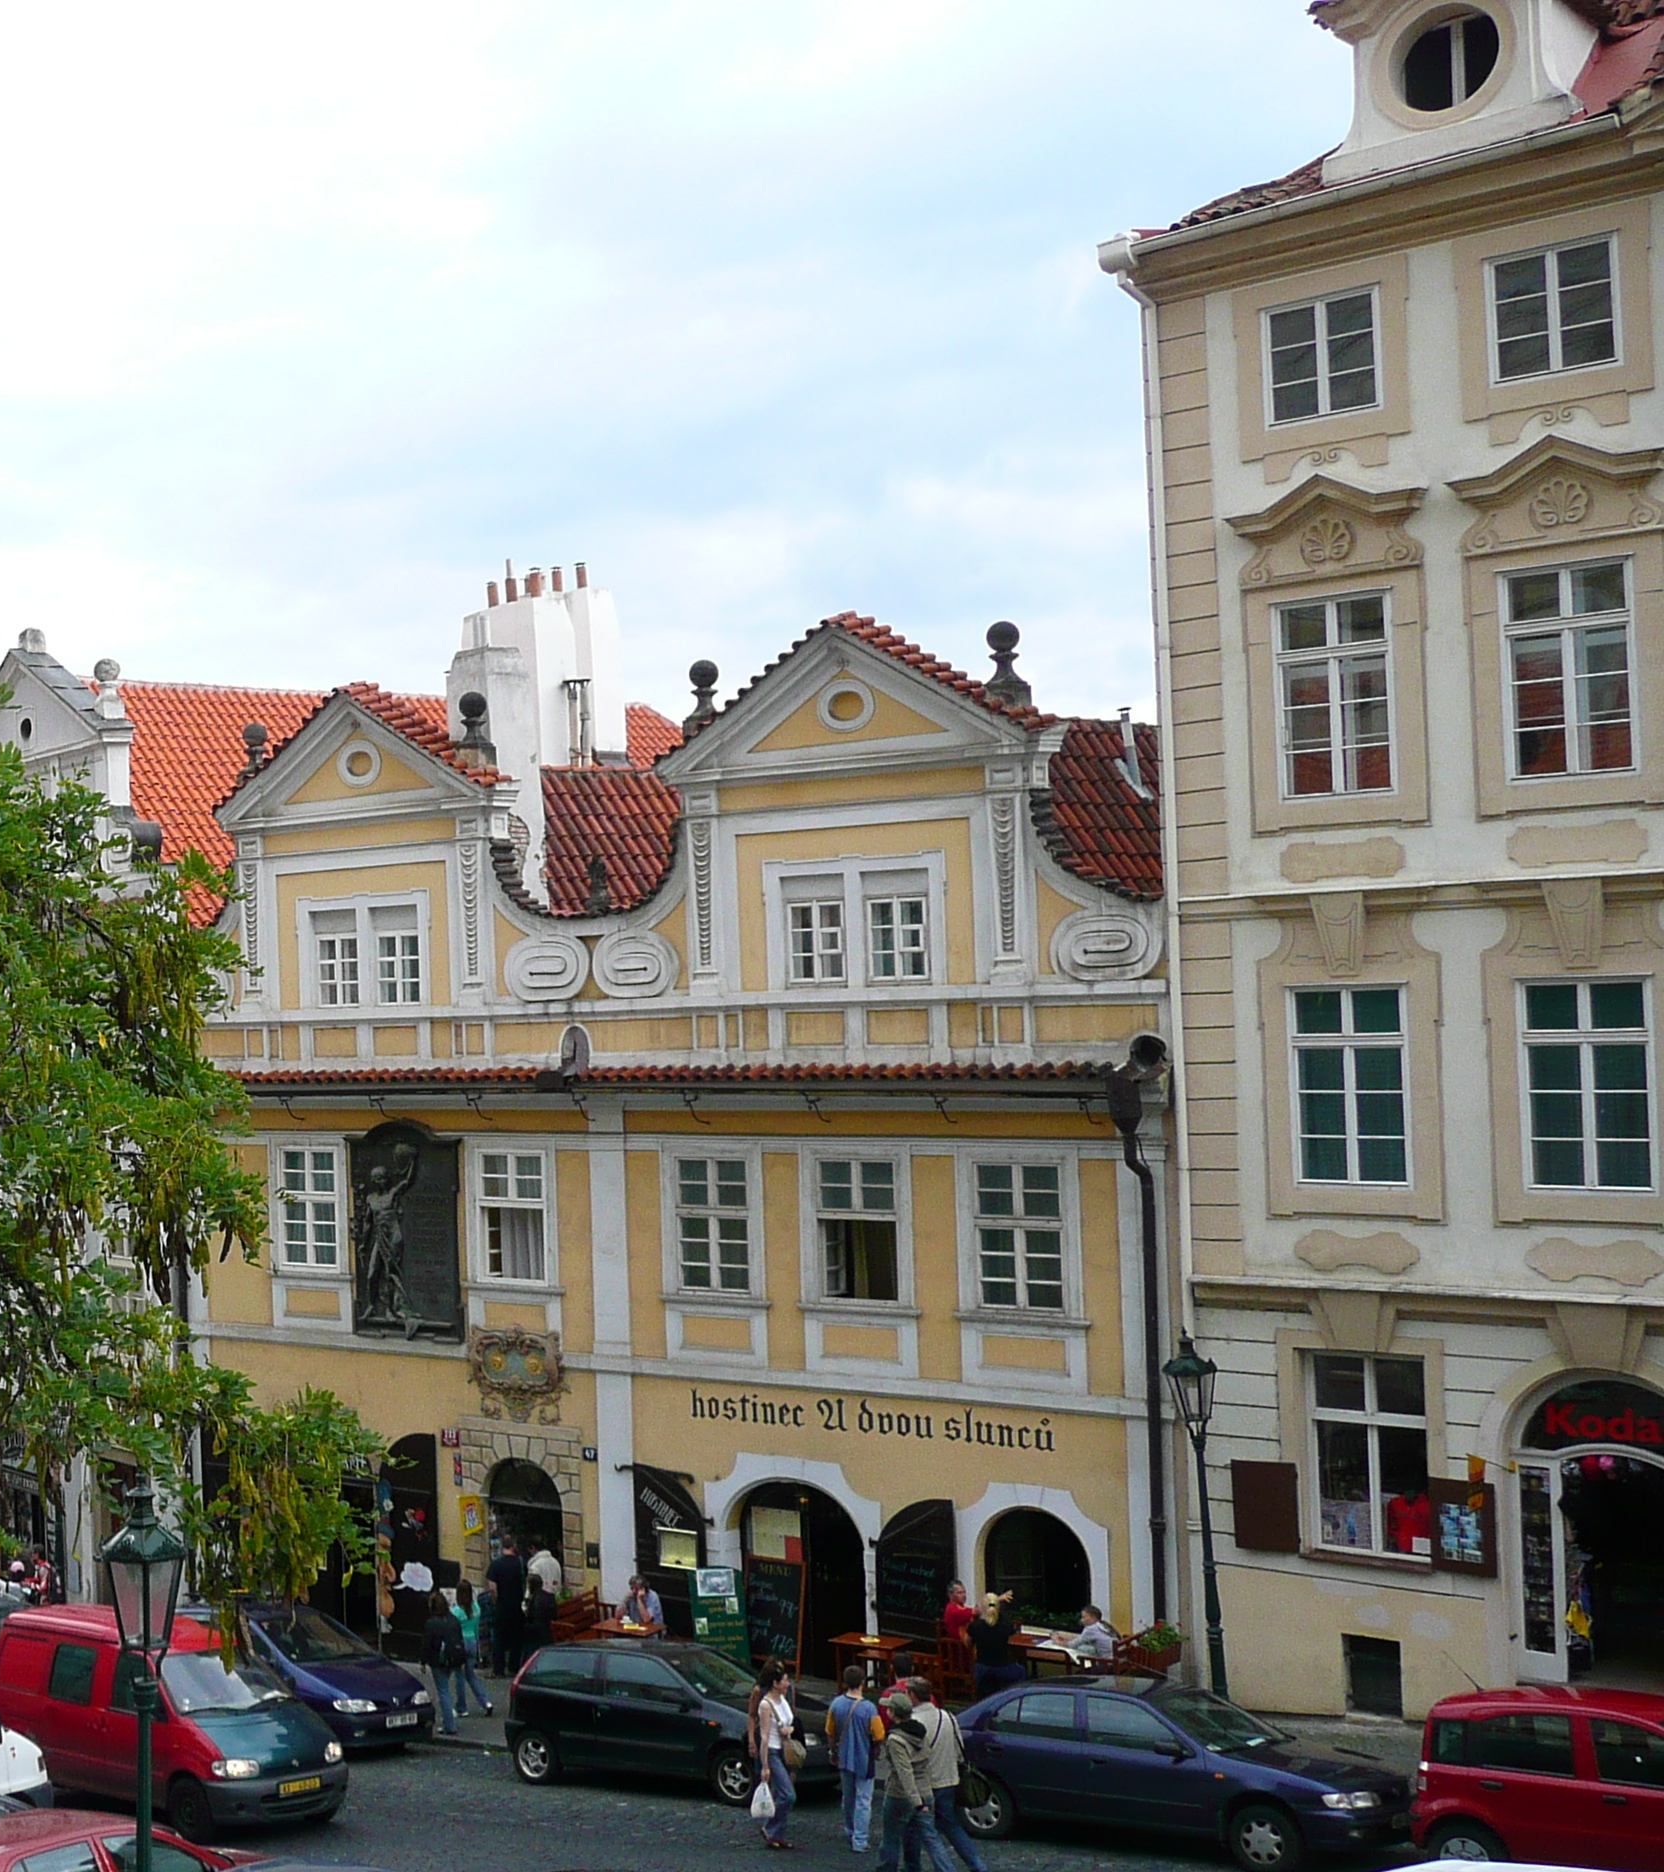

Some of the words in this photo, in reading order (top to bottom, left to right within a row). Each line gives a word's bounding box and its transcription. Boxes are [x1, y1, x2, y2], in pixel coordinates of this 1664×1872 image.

[691, 1388, 805, 1427] hostinec
[858, 1399, 934, 1440] dvou
[944, 1407, 1056, 1453] slunců
[1545, 1402, 1664, 1444] Koda
